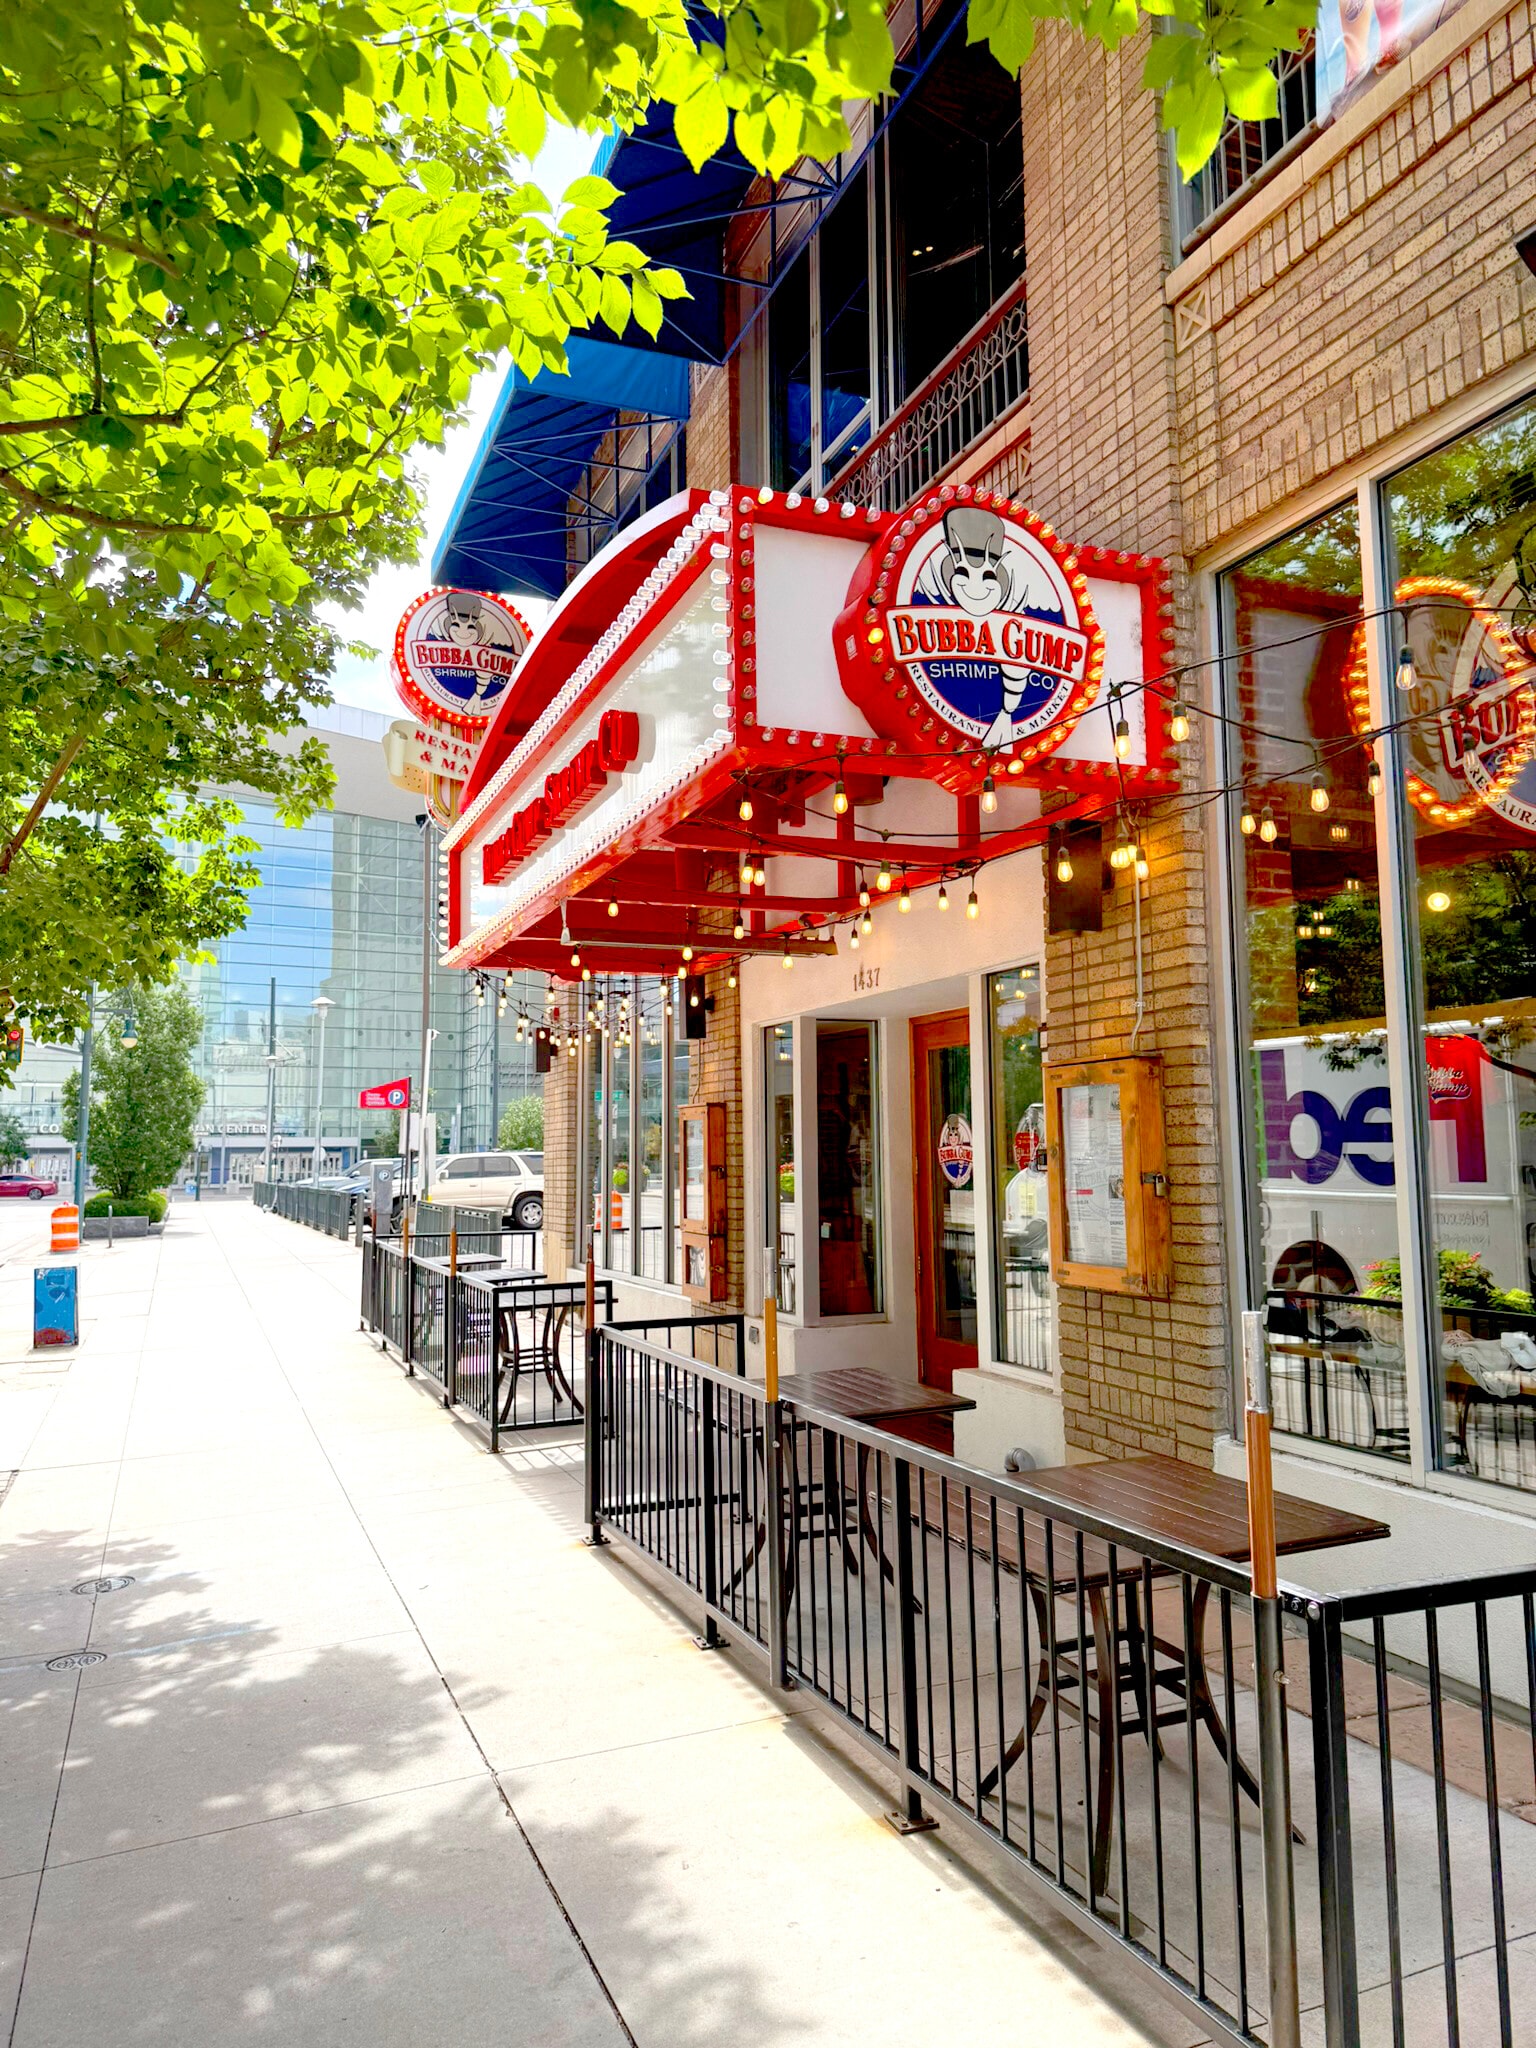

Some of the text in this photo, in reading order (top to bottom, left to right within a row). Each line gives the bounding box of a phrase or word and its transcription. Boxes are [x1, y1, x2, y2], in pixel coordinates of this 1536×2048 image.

[894, 615, 1083, 673] BUBBA GUMP
[416, 645, 517, 675] BUBBA GUM
[929, 663, 1000, 679] SHRIMP
[434, 668, 476, 679] SHRIMP
[911, 663, 984, 735] RESTAURANT
[1016, 683, 1069, 736] & MARKET
[415, 730, 477, 759] RESTA
[420, 751, 469, 775] & MA
[853, 967, 880, 991] 1437
[392, 1091, 401, 1103] P
[39, 1123, 60, 1134] CO
[218, 1123, 267, 1134] CENTER
